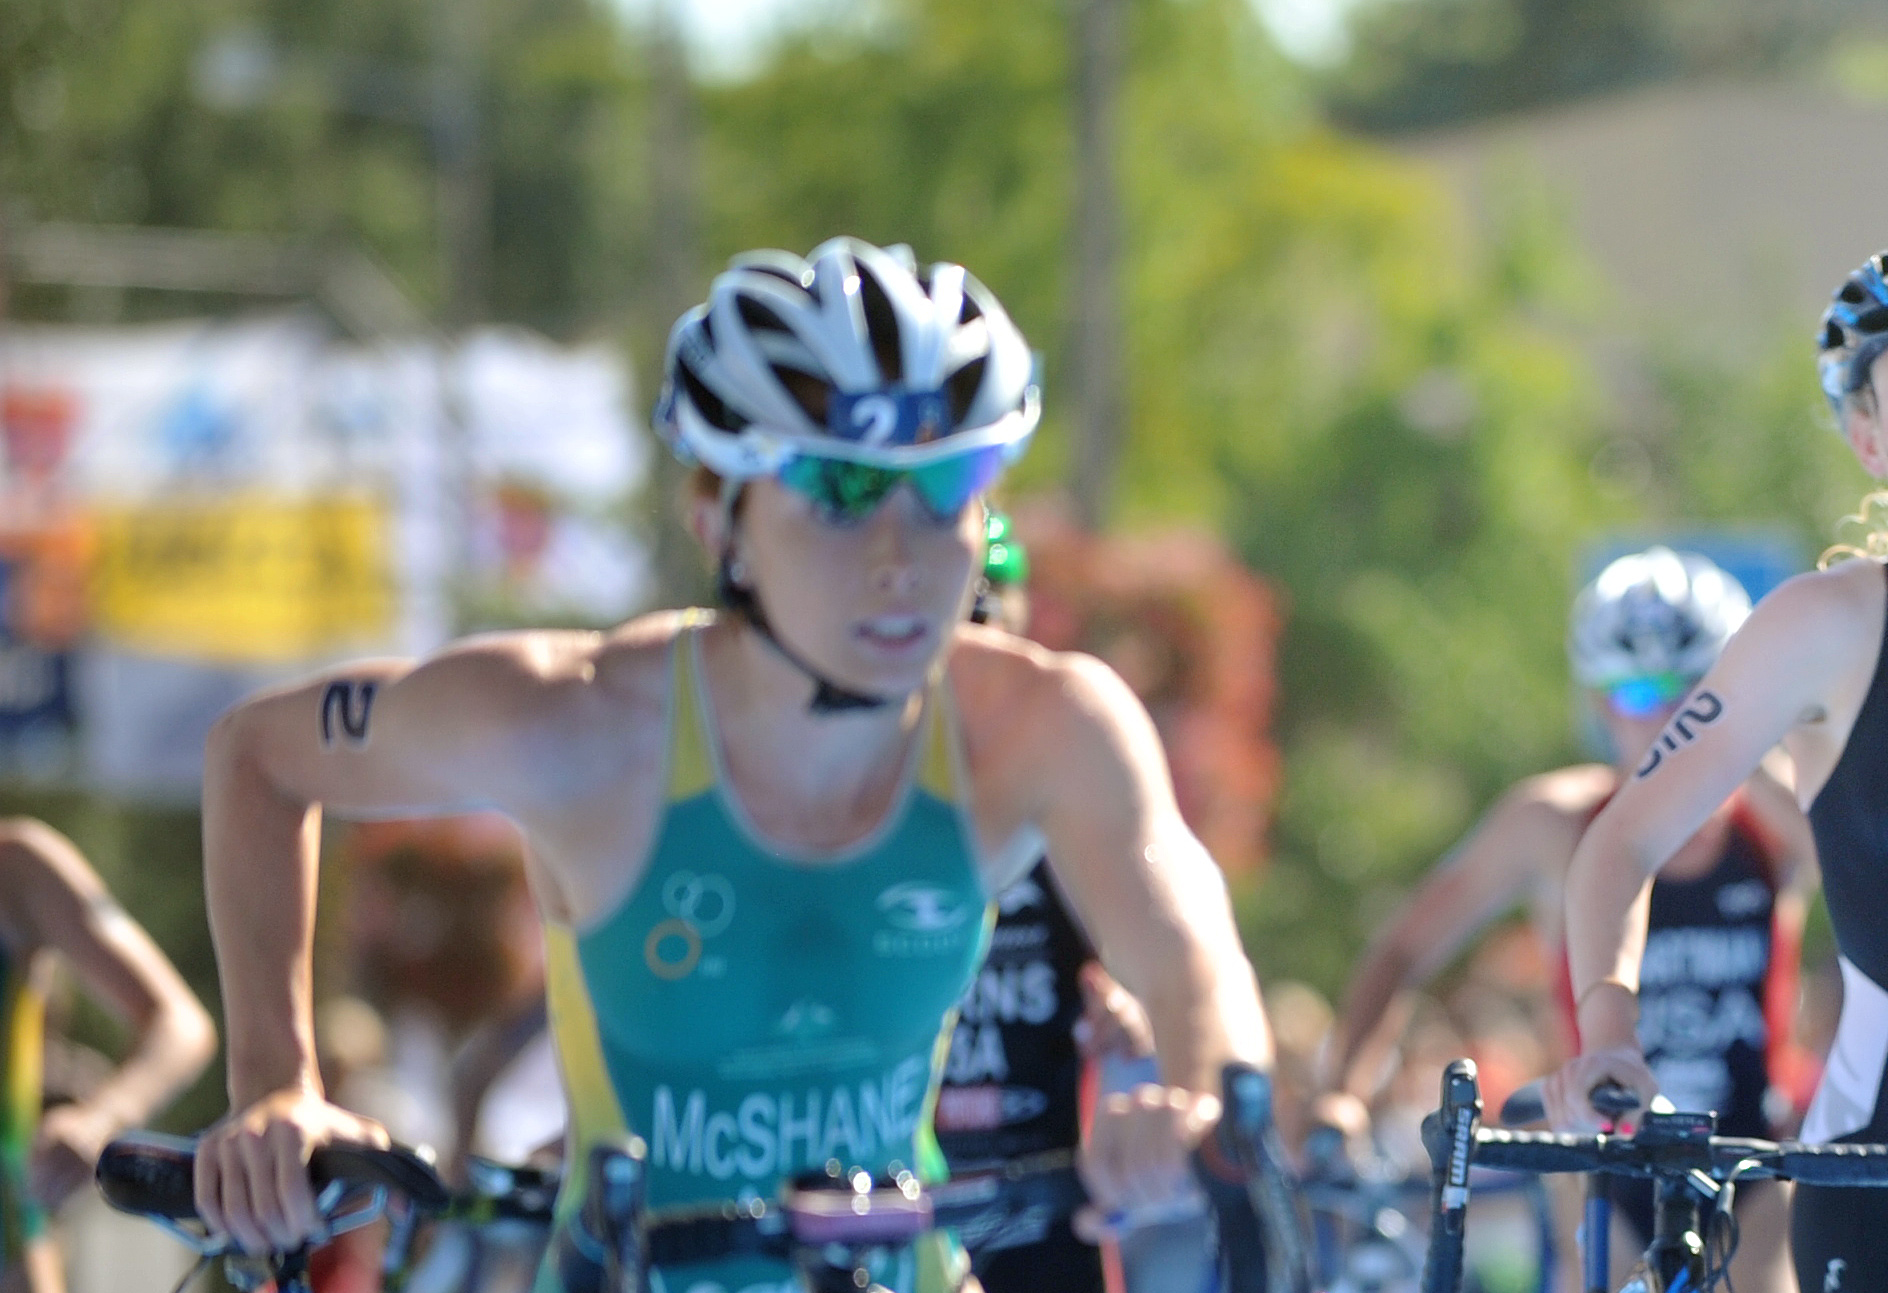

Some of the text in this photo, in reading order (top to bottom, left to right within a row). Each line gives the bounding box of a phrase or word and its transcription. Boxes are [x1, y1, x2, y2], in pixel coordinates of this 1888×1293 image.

[849, 395, 898, 450] 2
[321, 680, 378, 745] 2
[652, 1054, 931, 1181] McSHANE
